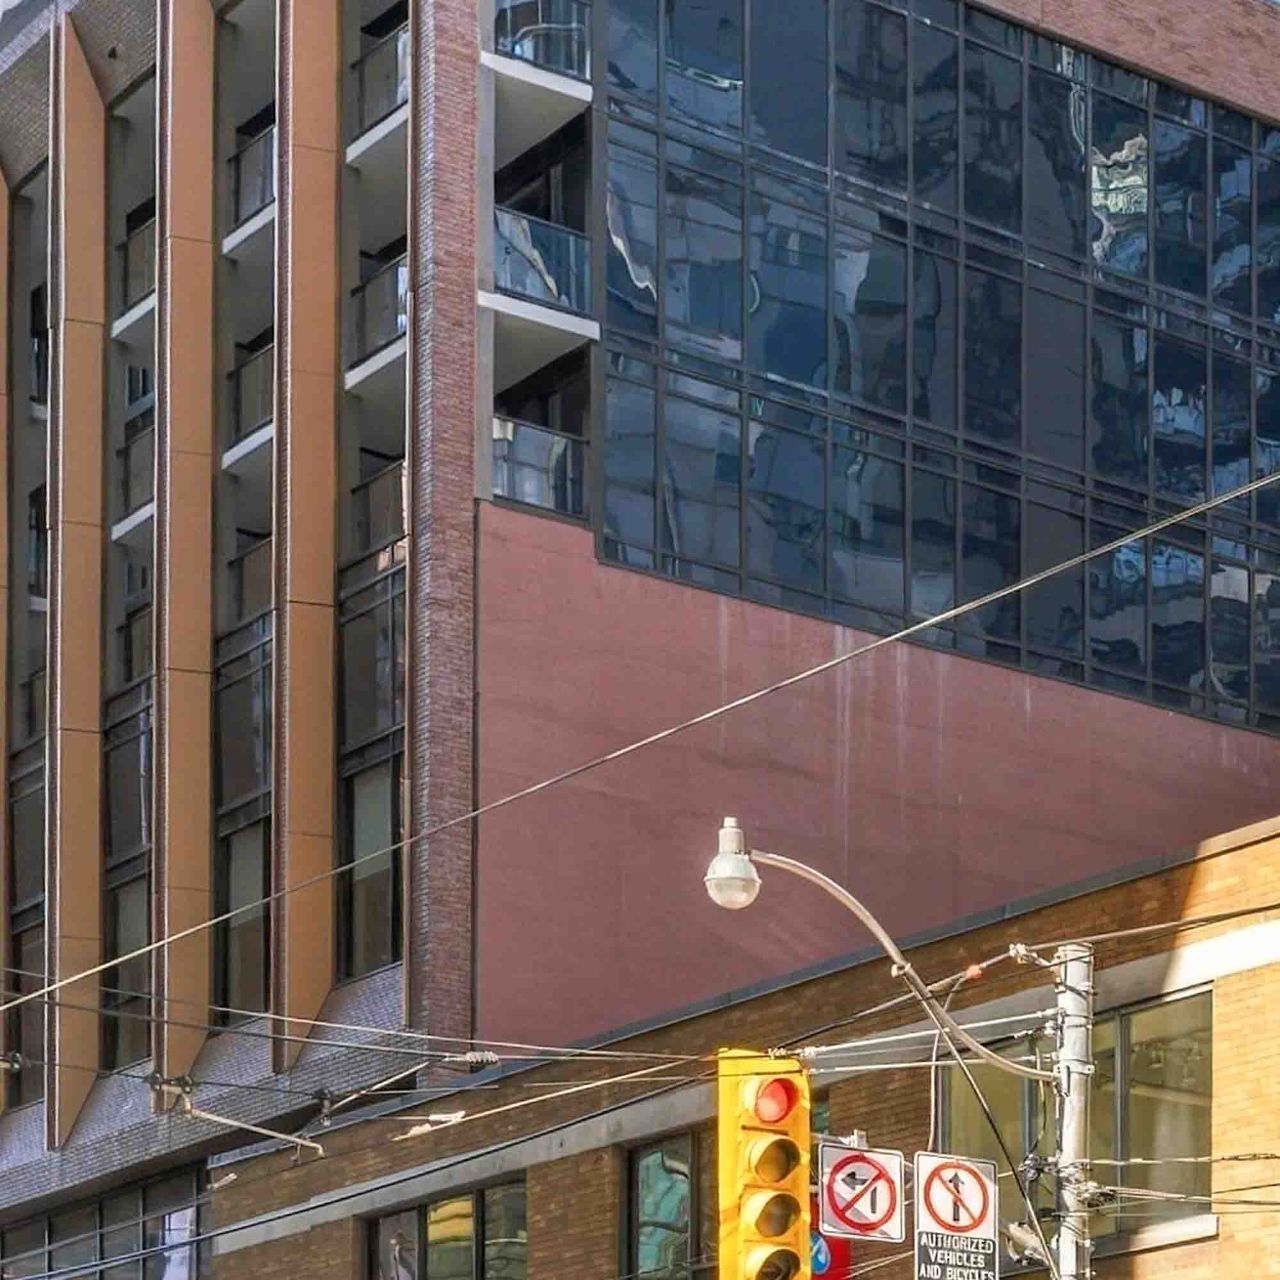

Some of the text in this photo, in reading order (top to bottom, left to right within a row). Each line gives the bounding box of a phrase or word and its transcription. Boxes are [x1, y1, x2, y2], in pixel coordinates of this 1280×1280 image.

[920, 1232, 994, 1254] AUTHORIZED
[929, 1248, 985, 1268] VEHICLES
[919, 1263, 942, 1280] AND
